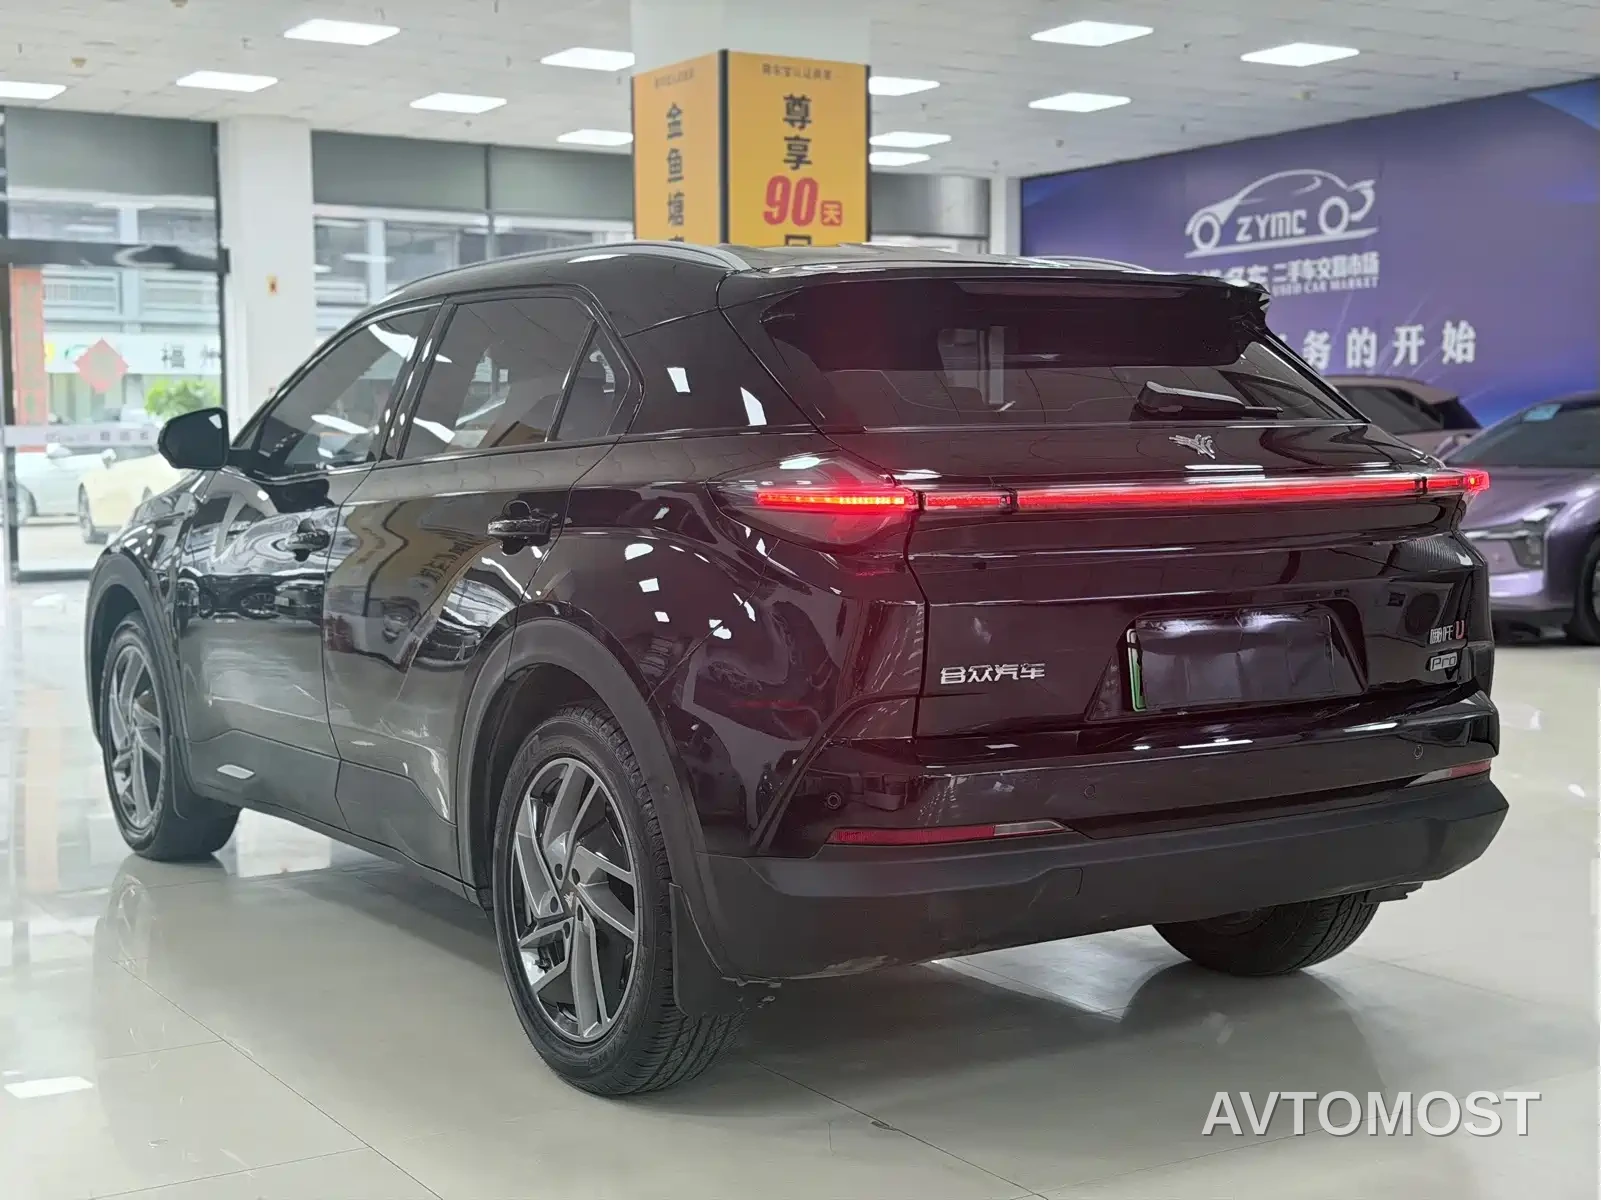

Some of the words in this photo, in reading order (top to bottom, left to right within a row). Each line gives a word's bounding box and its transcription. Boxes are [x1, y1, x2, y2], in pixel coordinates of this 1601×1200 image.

[782, 93, 812, 171] 尊享
[1236, 209, 1307, 243] ZYMC
[1280, 319, 1476, 371] 务的开始
[940, 663, 1045, 684] 合众汽车
